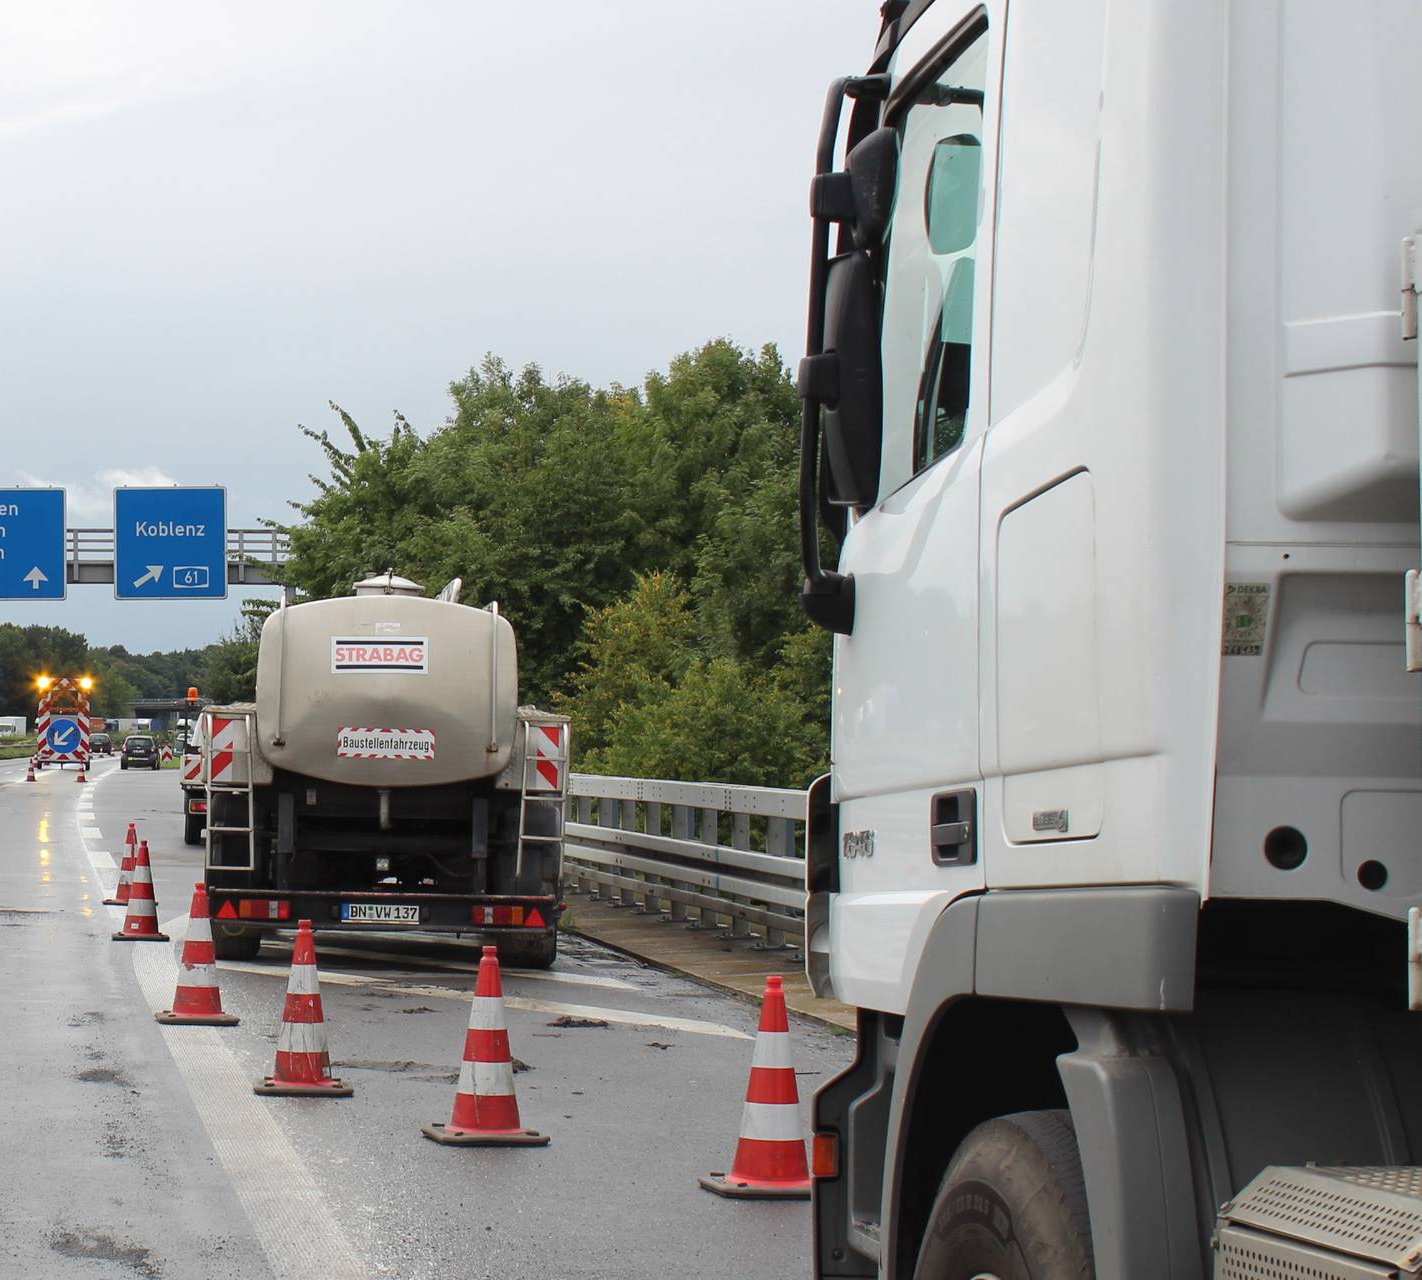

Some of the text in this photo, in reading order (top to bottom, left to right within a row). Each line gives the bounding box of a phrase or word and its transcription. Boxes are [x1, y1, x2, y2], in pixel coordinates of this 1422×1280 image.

[135, 521, 206, 537] Koblenz
[184, 570, 198, 584] 61
[1236, 585, 1267, 594] DEKRA
[335, 647, 425, 663] STRABAG
[343, 736, 430, 753] Baustellenfahrzeug
[375, 906, 392, 919] VW
[394, 907, 418, 920] 137
